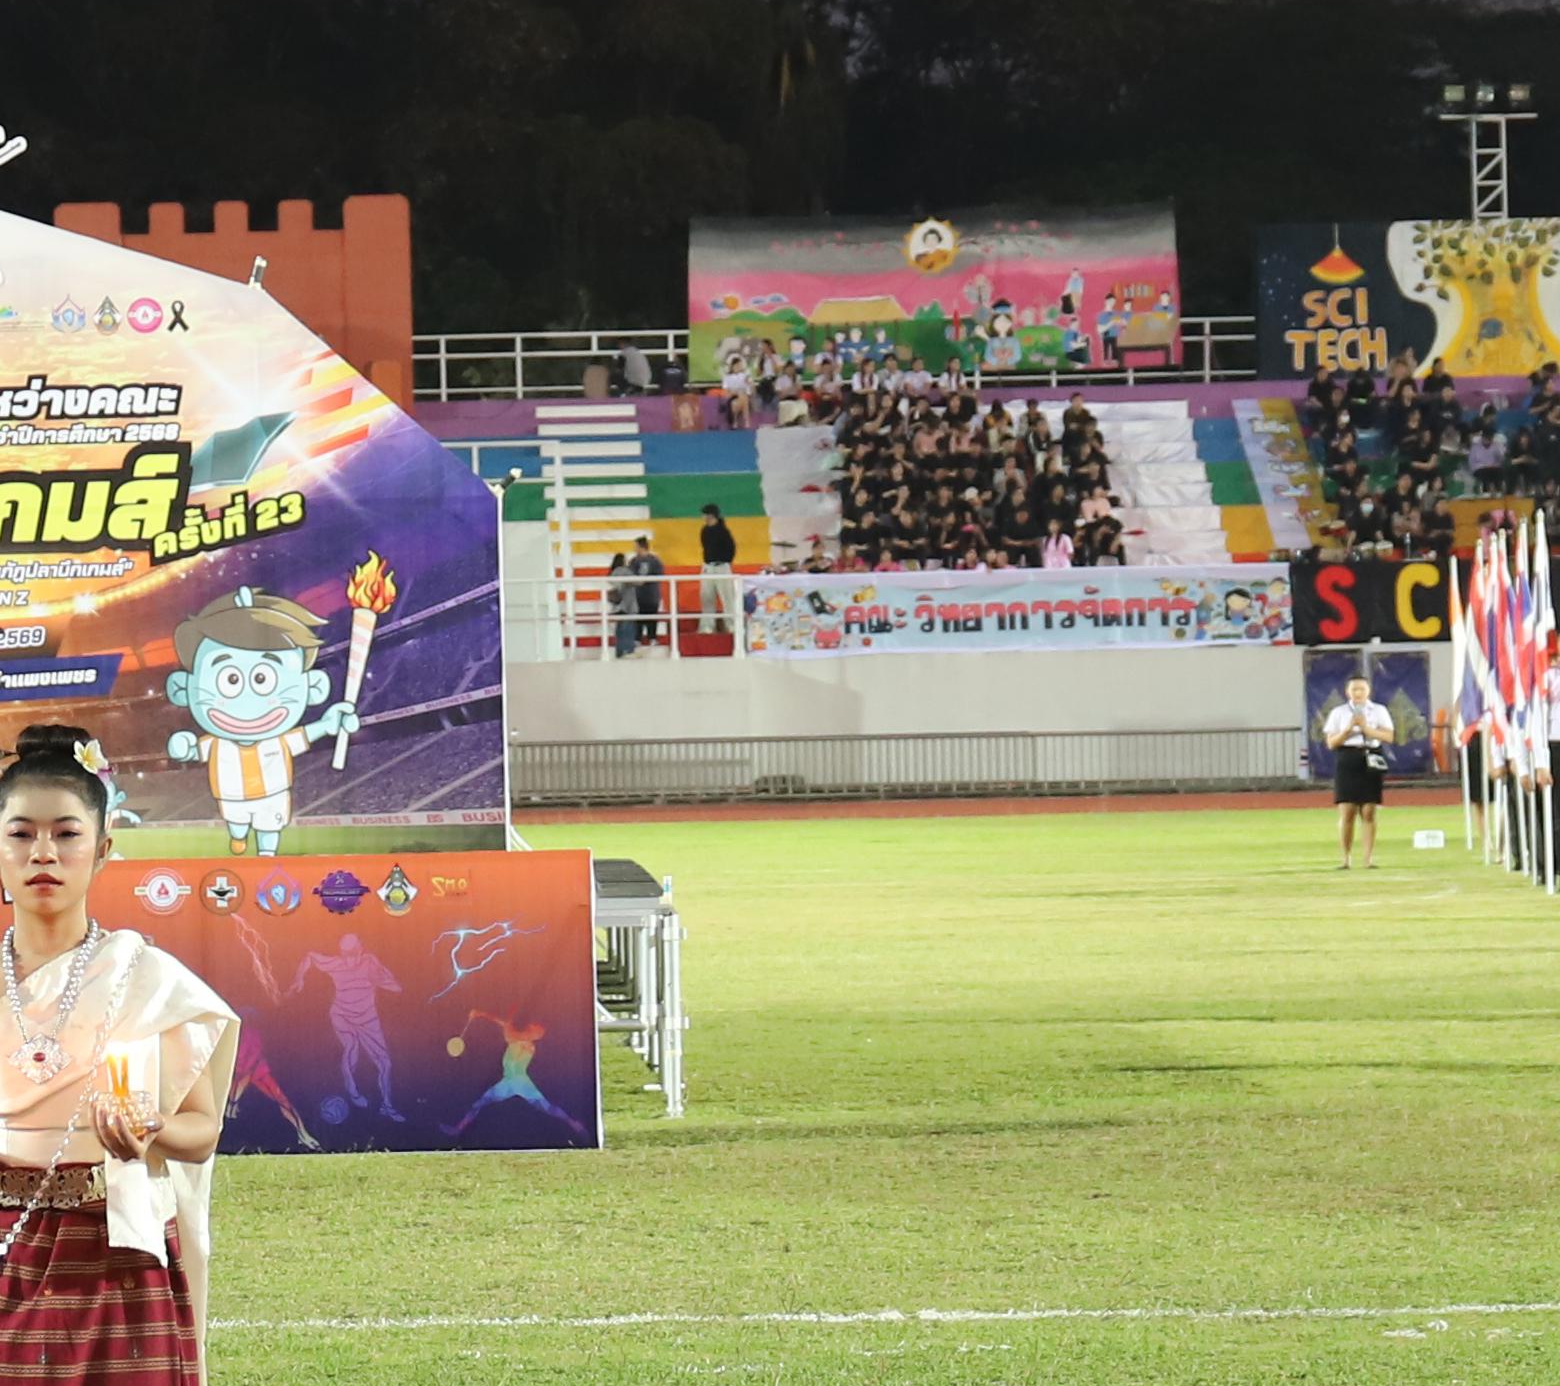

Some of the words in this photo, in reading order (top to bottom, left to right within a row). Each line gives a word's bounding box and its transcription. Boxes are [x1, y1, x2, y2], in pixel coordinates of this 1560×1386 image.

[1302, 288, 1369, 327] SCI
[1285, 327, 1388, 373] TECH
[125, 424, 180, 442] 2568
[153, 493, 248, 559] ครั้งที่
[255, 493, 304, 530] 23
[18, 591, 30, 605] Z
[1315, 566, 1355, 641] S
[1395, 563, 1440, 638] C
